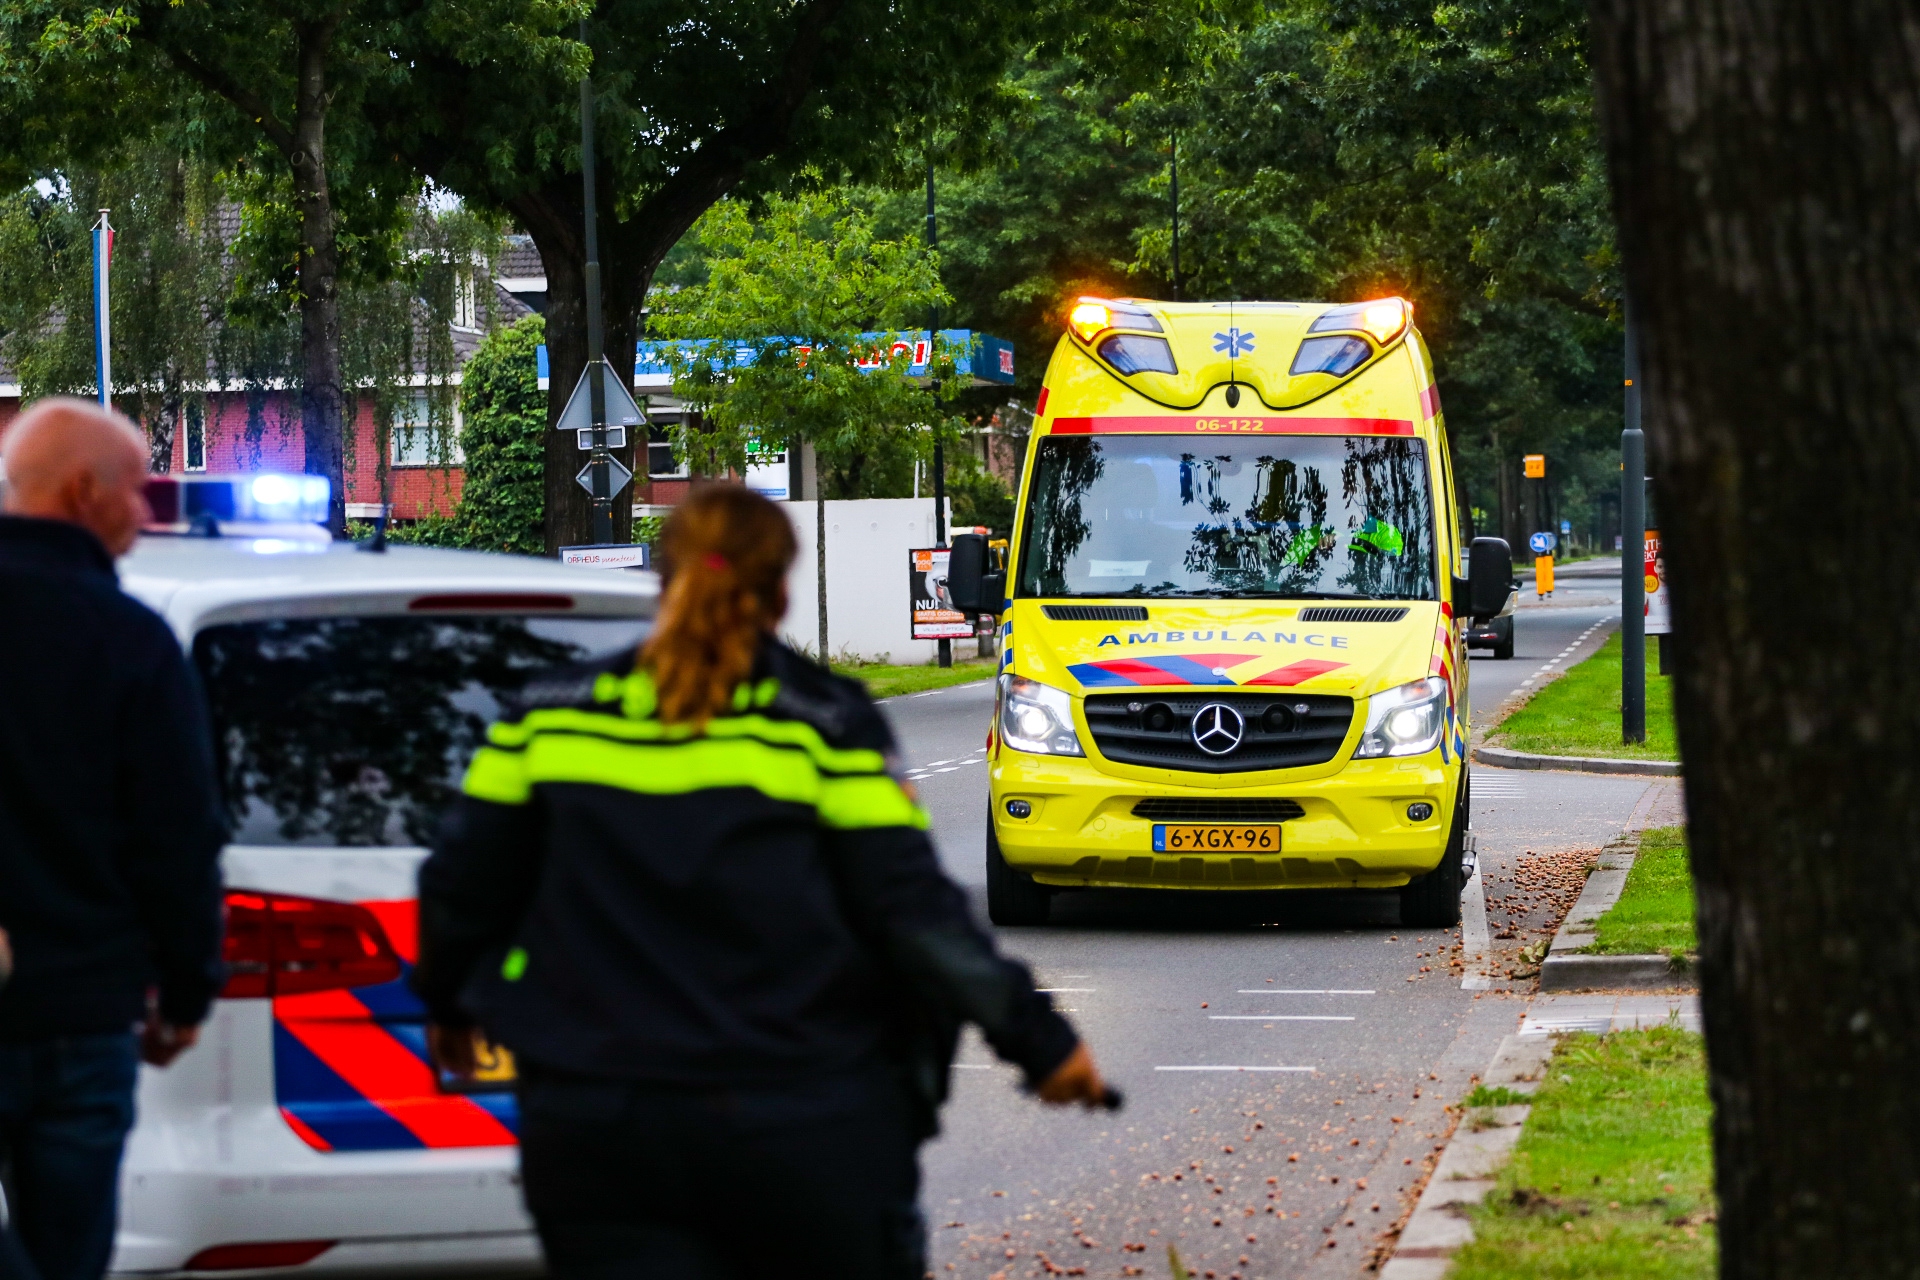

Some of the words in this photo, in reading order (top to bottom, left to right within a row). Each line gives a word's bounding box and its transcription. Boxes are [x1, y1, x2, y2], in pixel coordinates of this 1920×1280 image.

[1195, 419, 1264, 431] 06-122
[567, 556, 600, 564] ORPHEUS
[1097, 631, 1348, 648] AMBULANCE
[1170, 829, 1271, 848] 6-XGX-96
